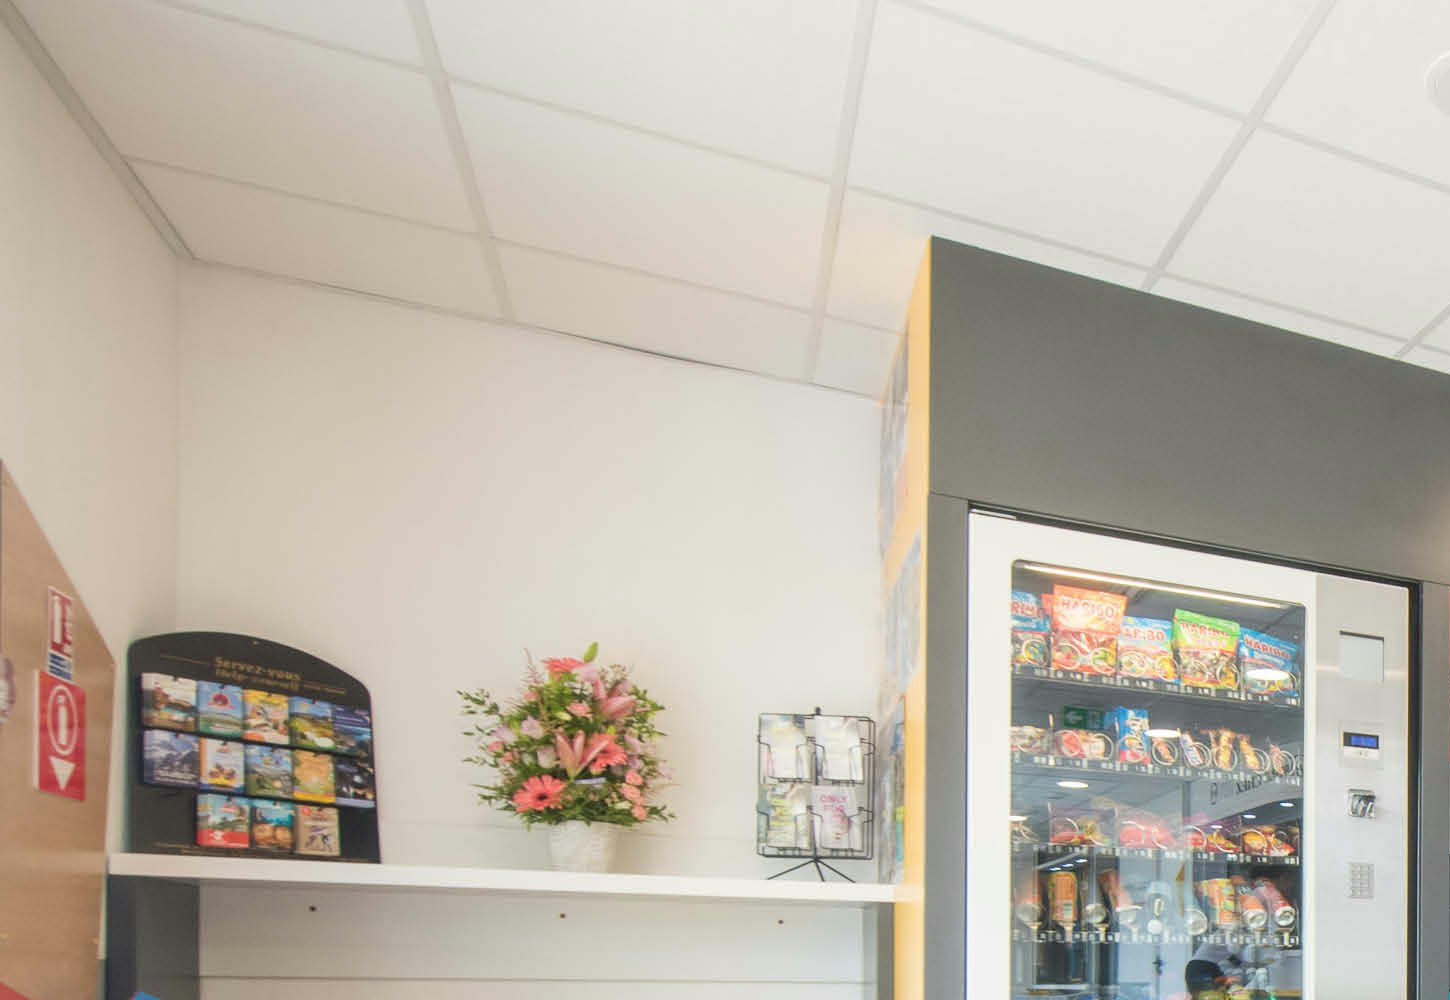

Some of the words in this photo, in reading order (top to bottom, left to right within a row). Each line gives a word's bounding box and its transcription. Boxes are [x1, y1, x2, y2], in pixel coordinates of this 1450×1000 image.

[1059, 596, 1116, 619] HARIBO
[1122, 625, 1166, 641] ARIBO
[1244, 635, 1291, 660] HARIBO
